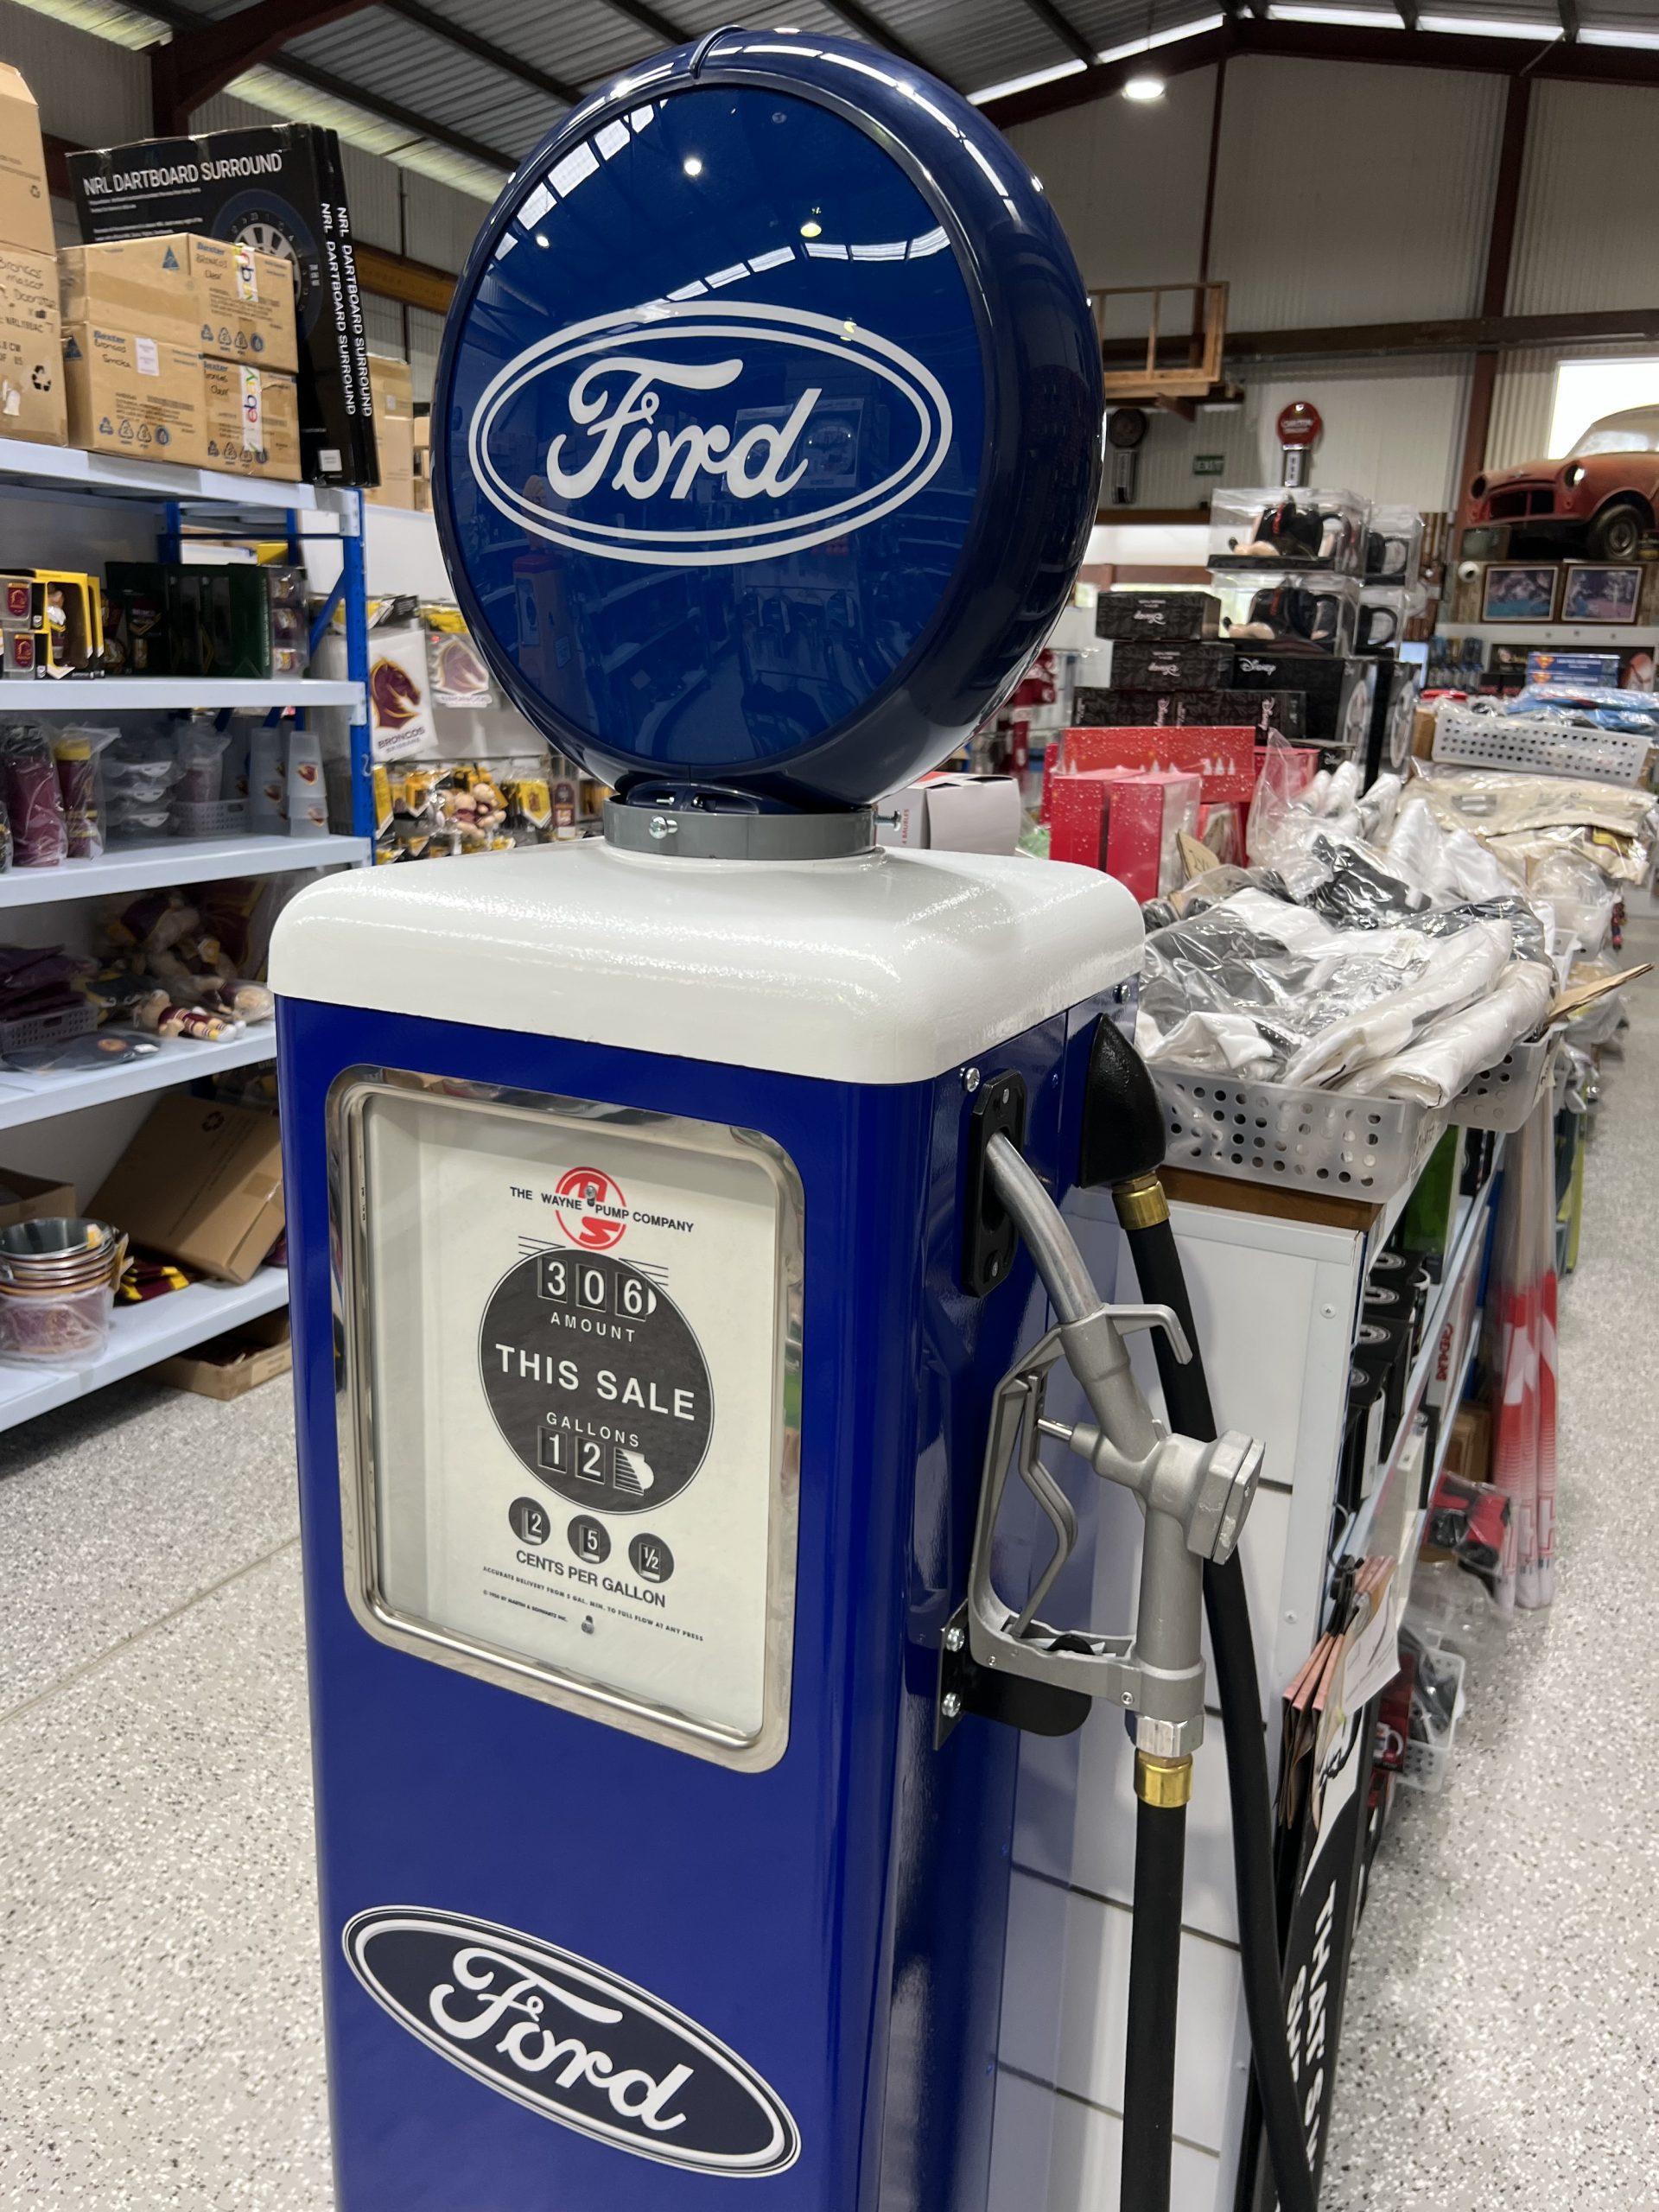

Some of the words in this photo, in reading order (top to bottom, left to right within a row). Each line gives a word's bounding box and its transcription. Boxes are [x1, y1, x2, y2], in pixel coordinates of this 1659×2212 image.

[84, 176, 112, 195] NRL
[113, 164, 200, 192] DARTBOARD
[200, 152, 283, 181] SURROUND
[321, 203, 334, 233] NRL
[337, 207, 350, 237] NRL
[326, 241, 346, 332] DARTBOARD
[342, 245, 363, 334] DARTBOARD
[338, 334, 356, 416] SURROUND
[355, 337, 372, 416] SURROUND
[546, 356, 823, 500] Ford
[1238, 657, 1277, 676] Disney
[378, 726, 426, 749] BRONCOS
[509, 1186, 533, 1200] THE
[541, 1192, 583, 1211] WAYNE
[595, 1204, 629, 1219] PUMP
[632, 1211, 694, 1233] COMPANY
[550, 1312, 636, 1343] AMOUNT
[495, 1343, 579, 1390] THIS
[596, 1370, 695, 1421] SALE
[546, 1411, 639, 1447] GALLONS
[531, 1512, 542, 1533] 2
[587, 1529, 599, 1551] 5
[483, 1566, 515, 1581] ACCURATE
[516, 1576, 545, 1591] DELIVERY
[546, 1586, 565, 1598] FROM
[618, 1610, 633, 1619] FULL
[634, 1615, 654, 1625] FLOW
[665, 1624, 681, 1635] ANY
[682, 1630, 704, 1642] PRESS
[516, 1549, 564, 1576] CENTS
[569, 1566, 598, 1586] PER
[602, 1577, 666, 1608] GALLON
[1305, 1879, 1337, 2126] THAT'S
[429, 1947, 694, 2131] Ford
